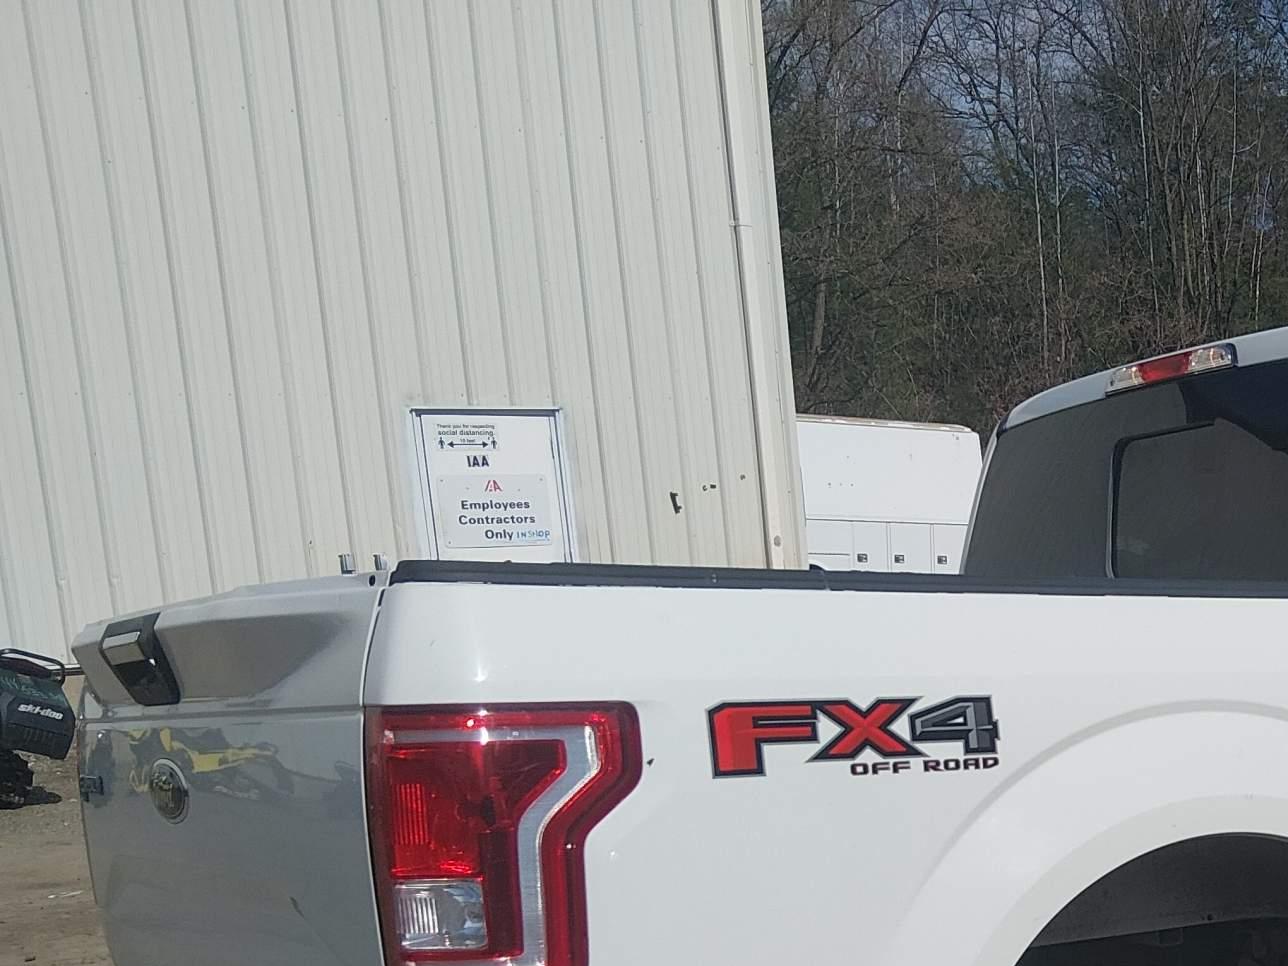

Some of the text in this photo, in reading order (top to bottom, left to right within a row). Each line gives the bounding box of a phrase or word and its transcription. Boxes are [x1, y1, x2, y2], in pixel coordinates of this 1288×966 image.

[467, 455, 490, 467] IAA
[461, 500, 530, 512] Employees
[459, 514, 536, 525] Contractors
[485, 529, 514, 541] Only
[18, 704, 63, 720] ski-doo
[705, 695, 1000, 779] FX4
[850, 756, 1000, 776] OFF ROAD
